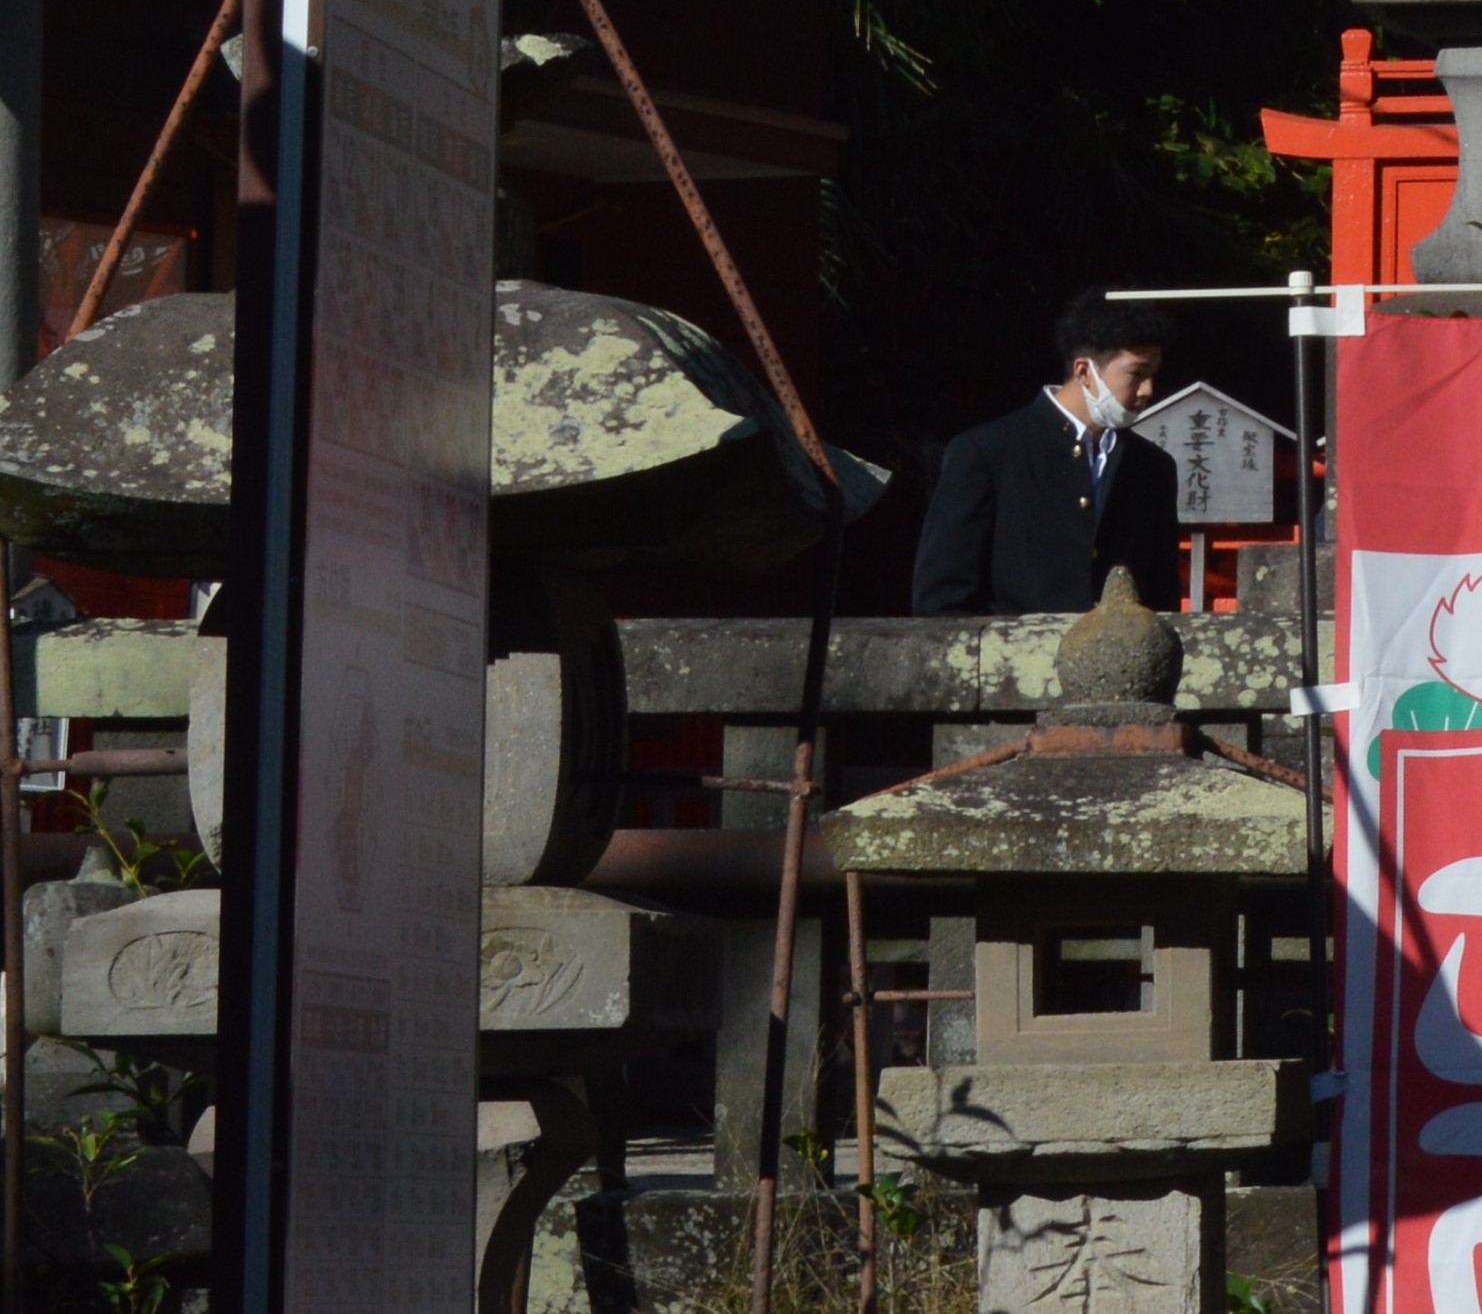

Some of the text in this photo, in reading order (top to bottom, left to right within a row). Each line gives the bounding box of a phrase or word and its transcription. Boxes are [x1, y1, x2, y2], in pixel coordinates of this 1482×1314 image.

[1183, 409, 1215, 514] 重要文化財
